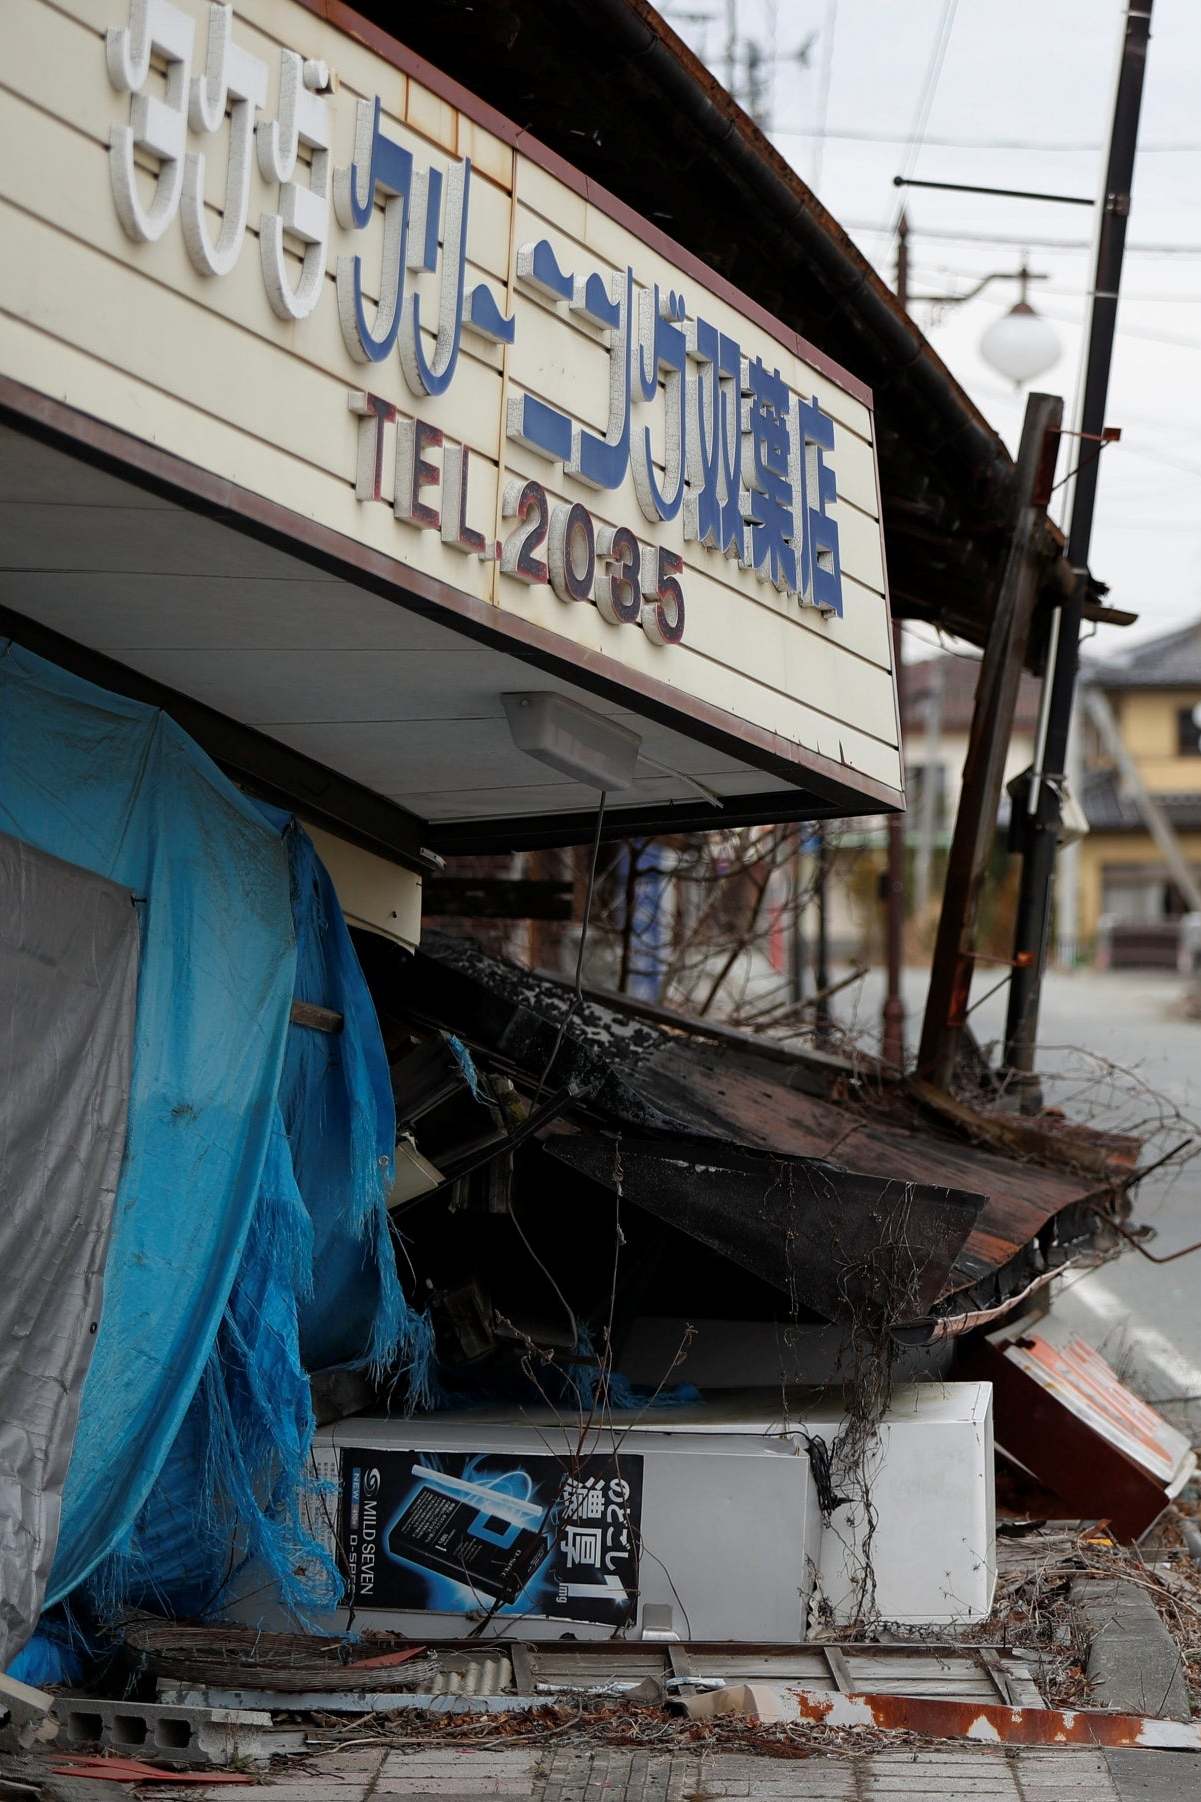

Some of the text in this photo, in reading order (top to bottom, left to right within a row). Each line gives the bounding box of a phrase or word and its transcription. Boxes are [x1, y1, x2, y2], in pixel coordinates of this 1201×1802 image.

[352, 1472, 361, 1500] NEW
[560, 1476, 606, 1569] 濃厚
[605, 1477, 631, 1572] のどごし
[360, 1500, 378, 1595] MILD SEVEN
